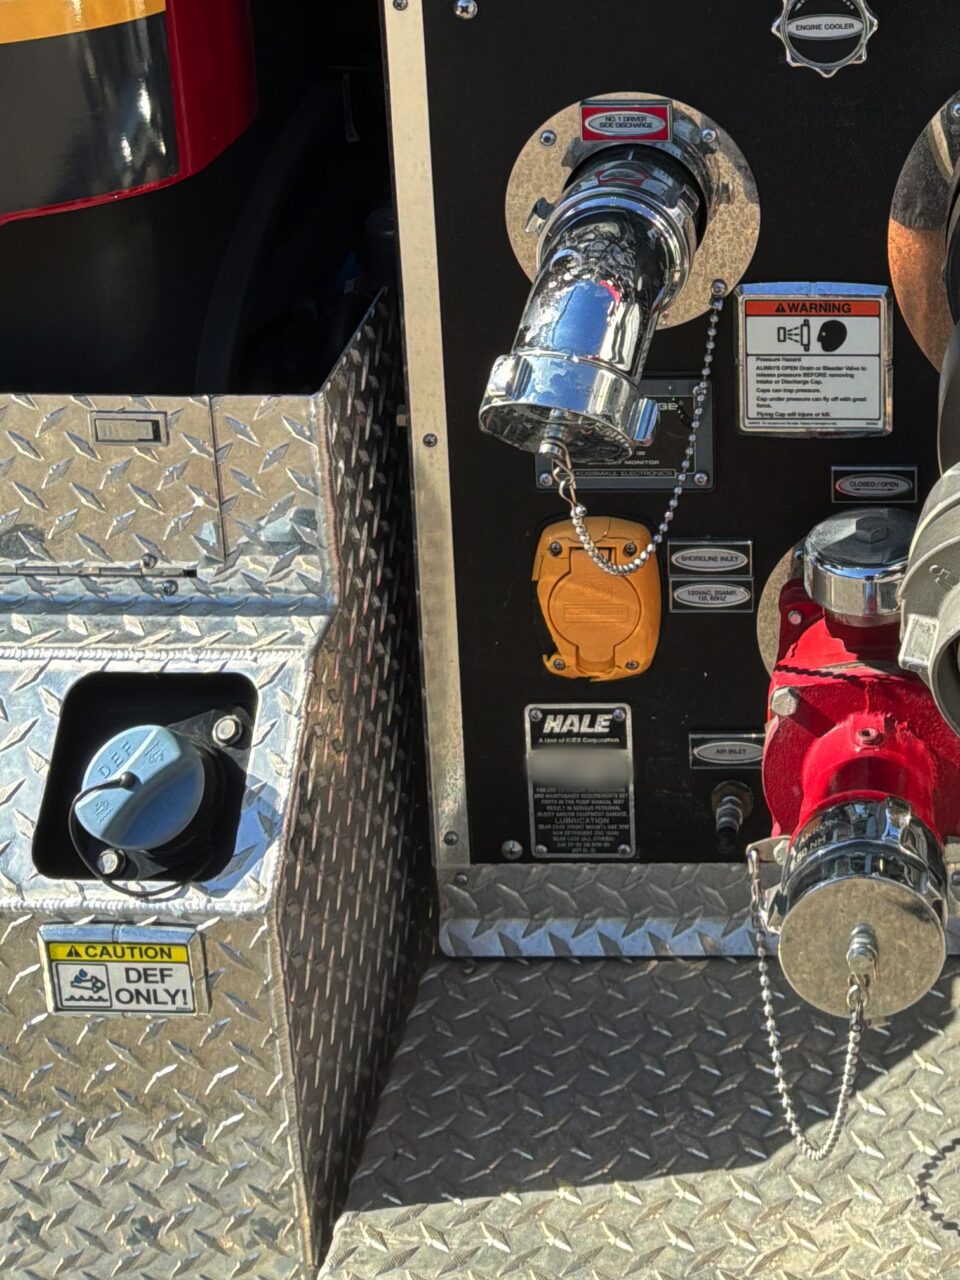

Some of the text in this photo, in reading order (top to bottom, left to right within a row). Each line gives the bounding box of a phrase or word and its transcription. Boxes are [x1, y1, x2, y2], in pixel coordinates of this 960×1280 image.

[787, 303, 852, 313] WARNING
[543, 714, 613, 733] HALE
[98, 741, 132, 779] DEF
[85, 945, 172, 959] CAUTION
[125, 967, 173, 984] DEF
[115, 988, 188, 1005] ONLY!
